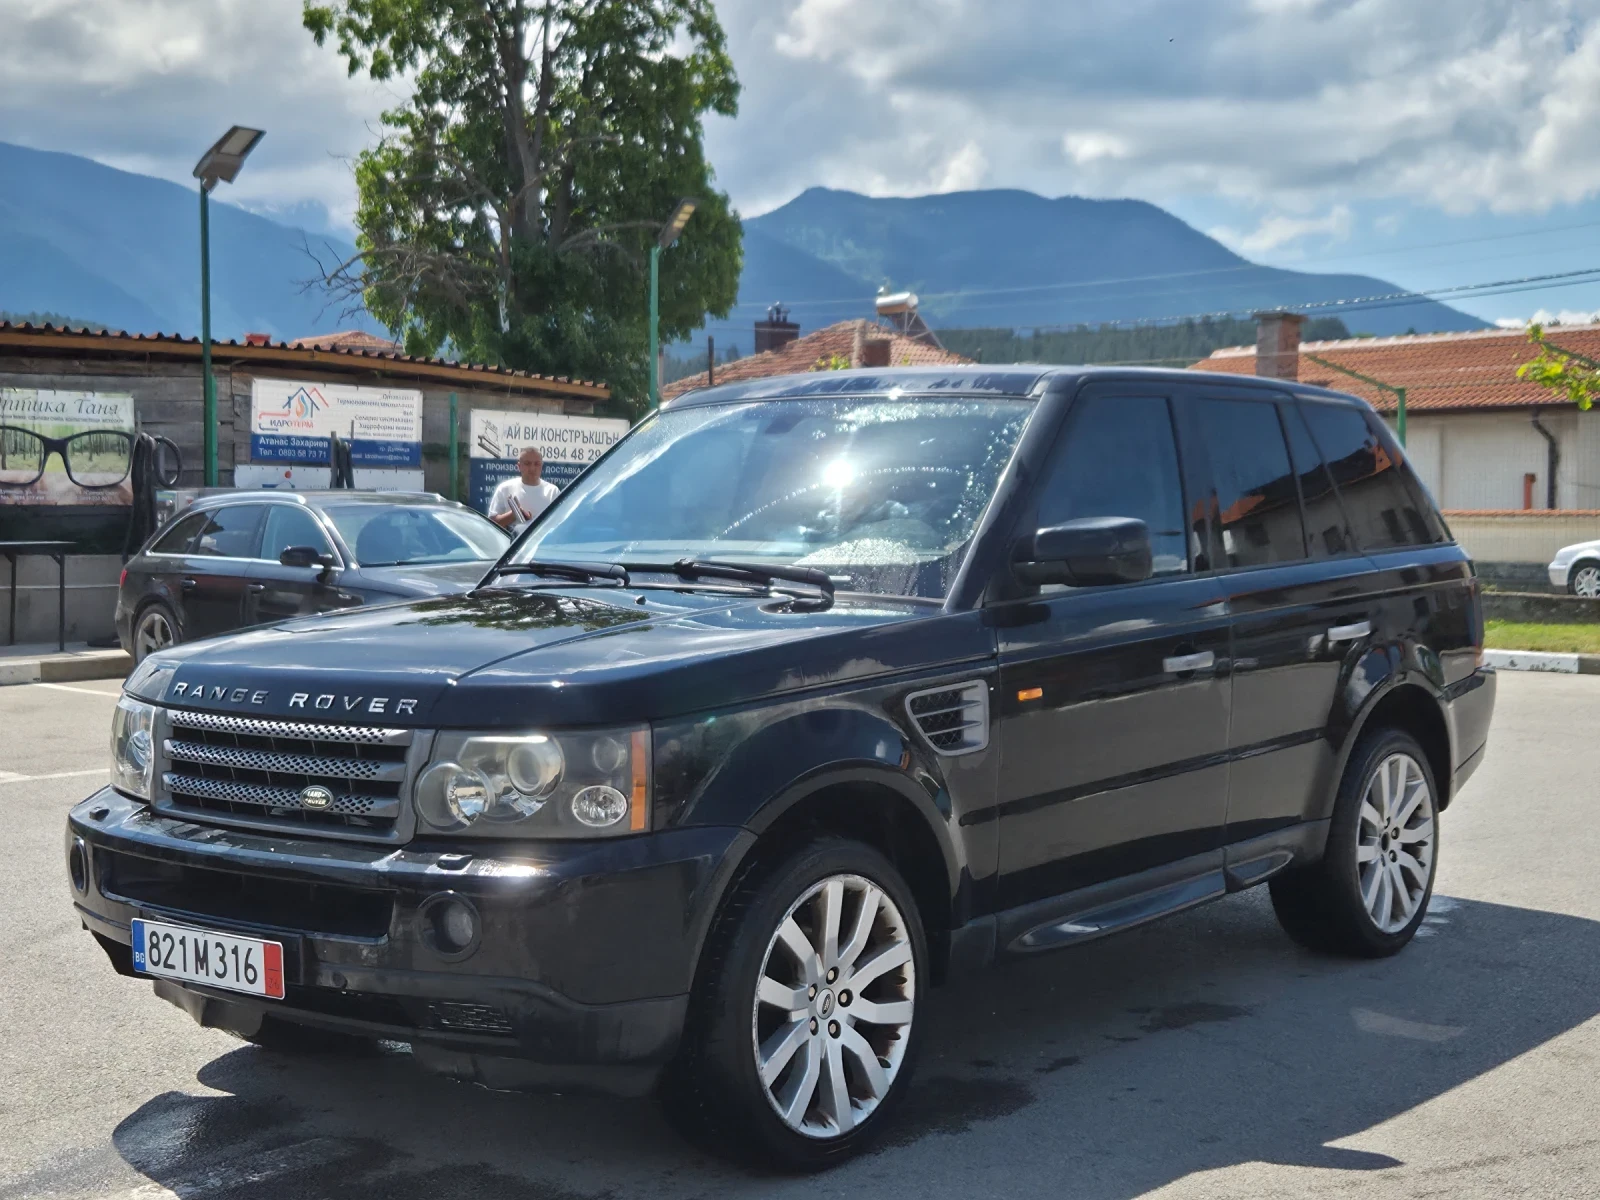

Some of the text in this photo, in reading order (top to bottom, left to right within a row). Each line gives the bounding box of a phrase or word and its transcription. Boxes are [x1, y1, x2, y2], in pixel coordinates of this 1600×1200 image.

[0, 396, 119, 415] птика Таня
[506, 421, 619, 445] АЙ ВИ КОНСТРЪКШЪН
[259, 436, 328, 448] Атанас Захариев
[278, 448, 296, 457] 0893
[308, 450, 317, 458] 73
[318, 451, 327, 459] 71
[540, 445, 567, 460] 0894
[571, 447, 584, 460] 48
[588, 448, 602, 462] 29
[545, 465, 581, 474] ДОСТАВКА
[485, 474, 496, 482] НА
[172, 681, 419, 715] RANGE ROVER
[307, 790, 322, 798] LAND
[135, 951, 145, 963] BG
[148, 930, 258, 985] 821M316
